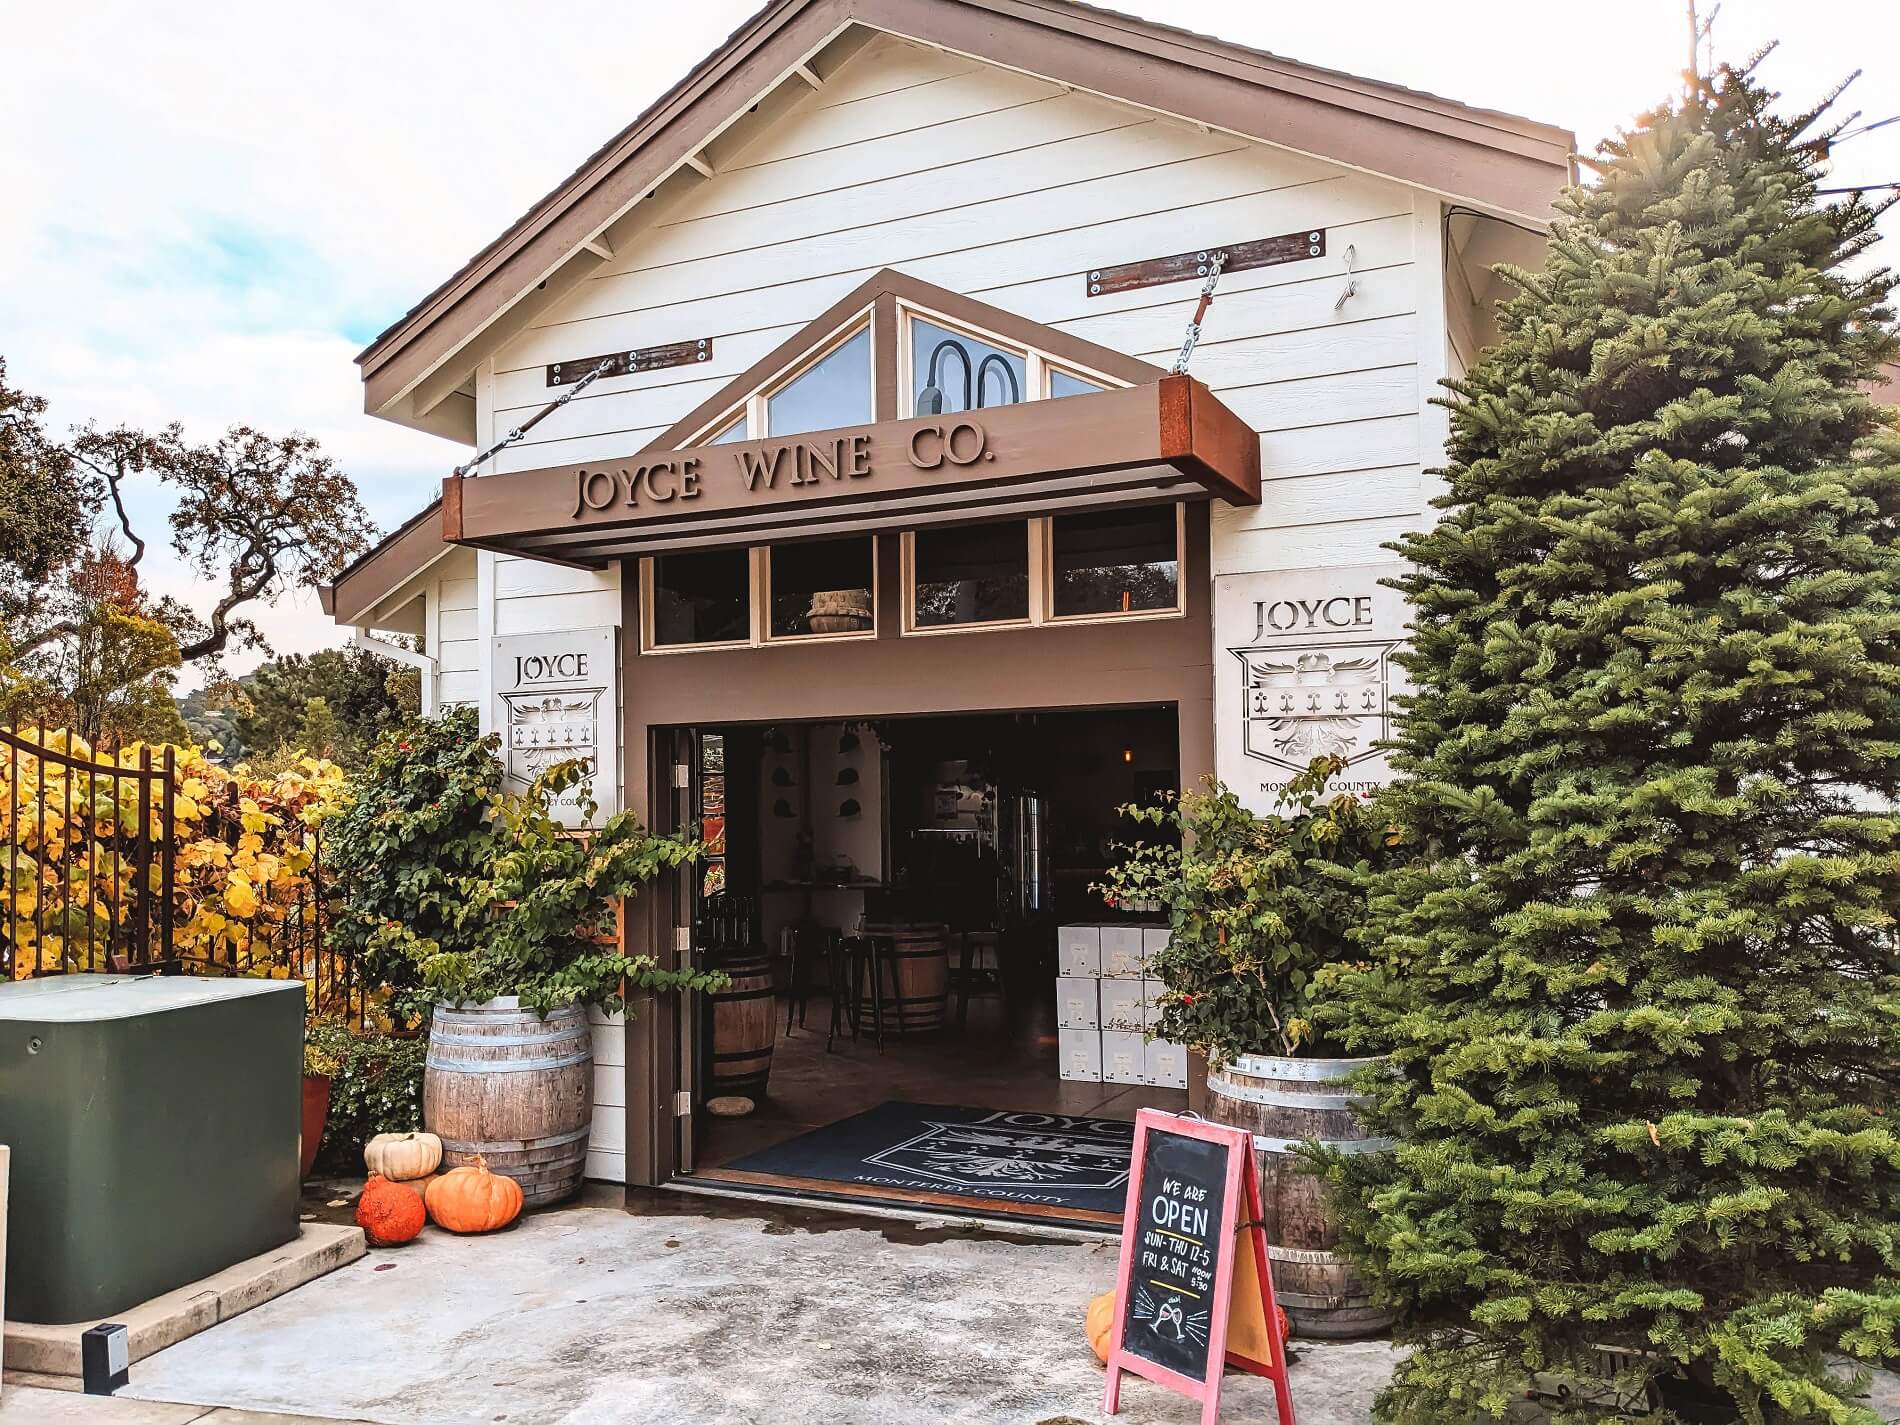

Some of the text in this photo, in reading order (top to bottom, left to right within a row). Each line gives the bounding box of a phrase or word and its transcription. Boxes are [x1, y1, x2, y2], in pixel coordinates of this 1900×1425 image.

[571, 423, 995, 518] JOYCE WINE CO.
[1251, 597, 1373, 642] JOYCE
[514, 653, 589, 688] JOYCE
[971, 1111, 1136, 1134] JOYC
[854, 1174, 1071, 1203] MONTEREY COUNTY
[1163, 1178, 1207, 1201] WE ARE
[1152, 1196, 1208, 1237] OPEN
[1142, 1251, 1189, 1278] FRI & SAT
[1190, 1245, 1211, 1266] 12-5
